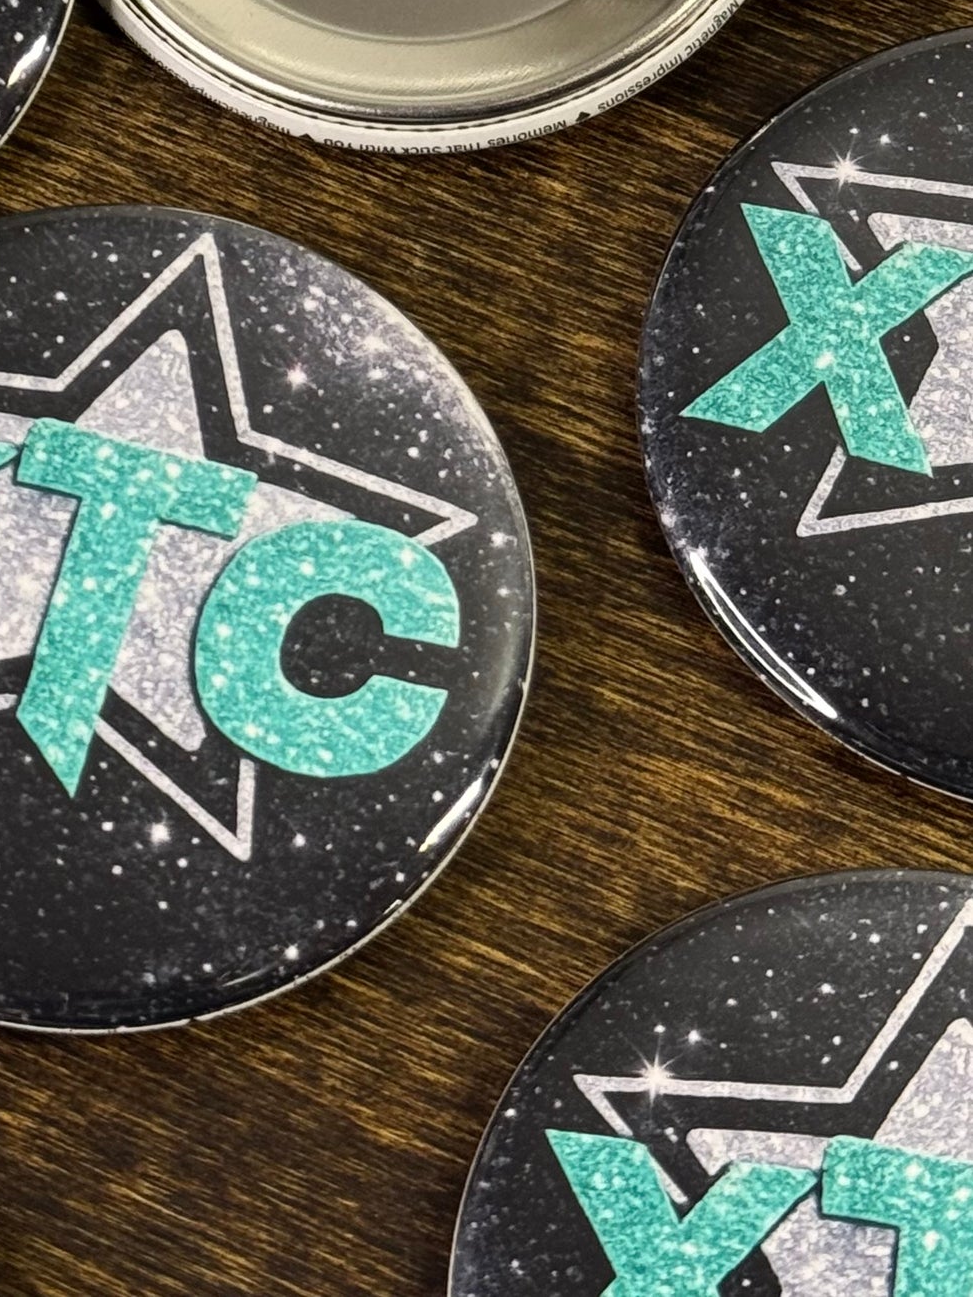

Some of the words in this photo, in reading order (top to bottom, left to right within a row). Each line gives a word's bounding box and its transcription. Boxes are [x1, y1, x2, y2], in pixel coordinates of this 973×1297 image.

[682, 0, 740, 58] Magnetic
[597, 52, 683, 113] Impressions
[487, 118, 568, 147] Memories
